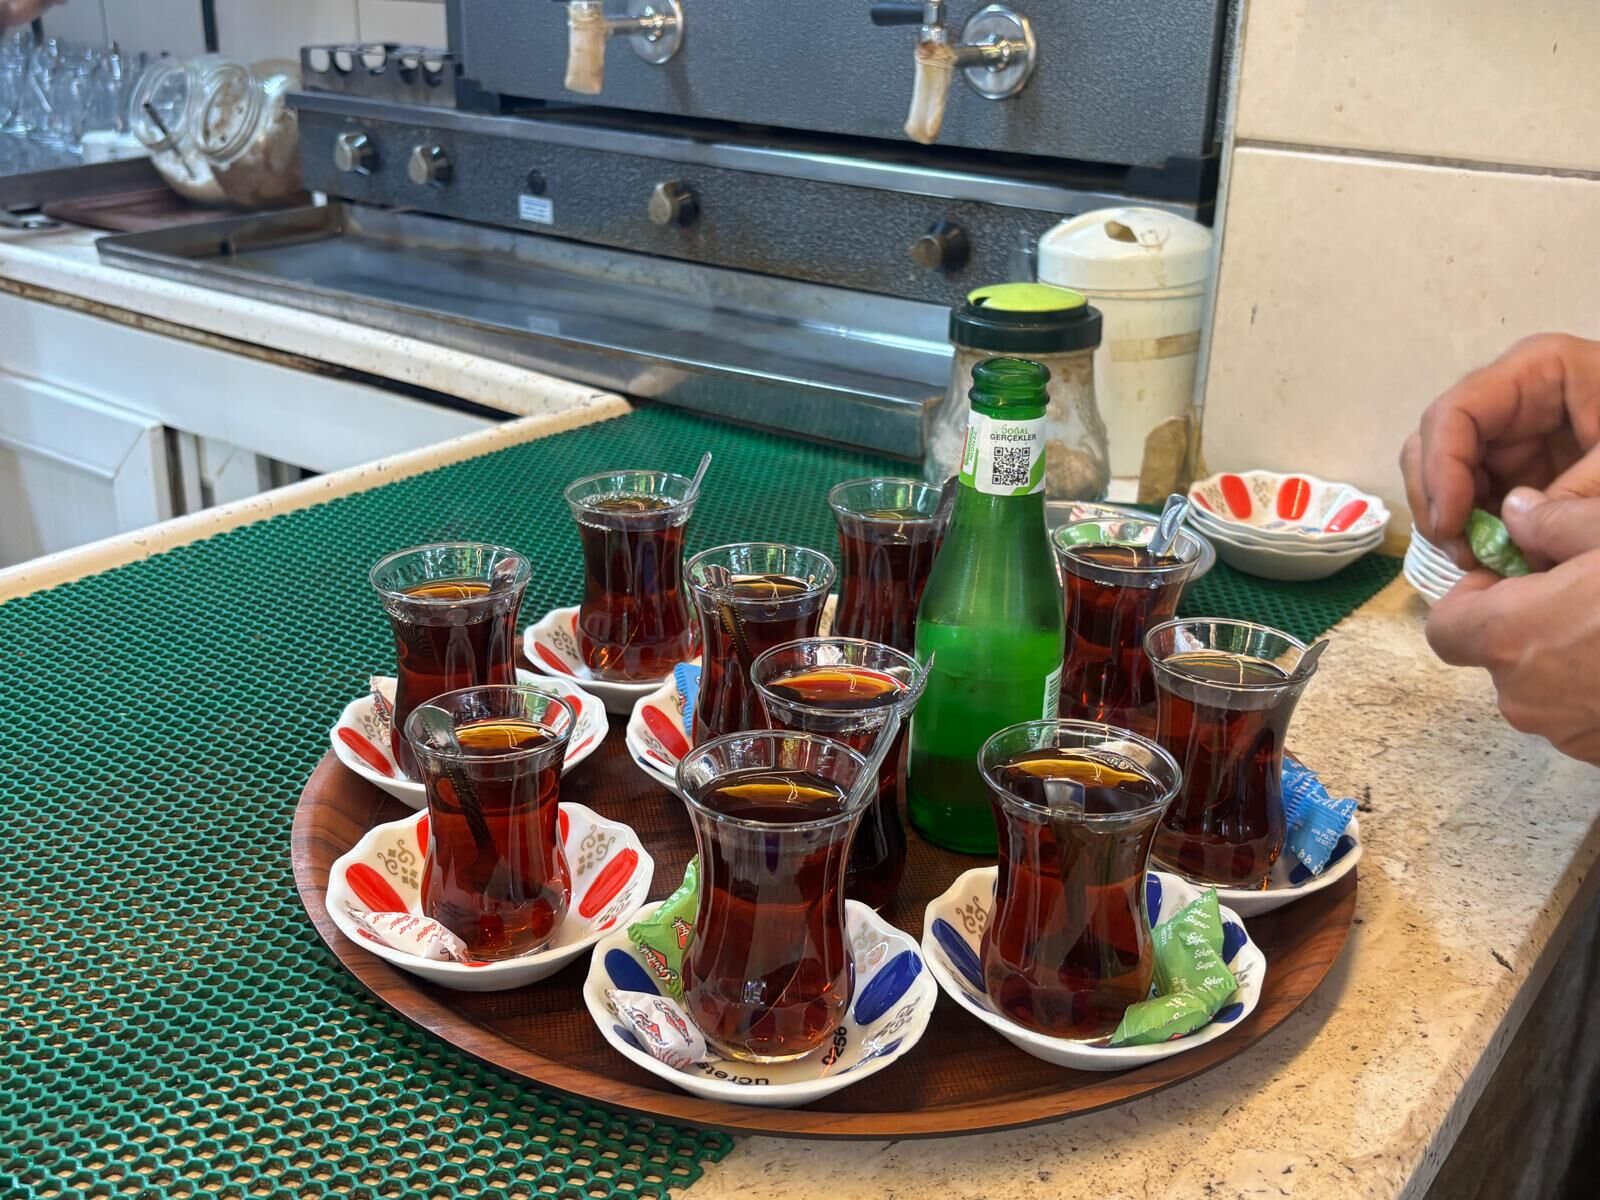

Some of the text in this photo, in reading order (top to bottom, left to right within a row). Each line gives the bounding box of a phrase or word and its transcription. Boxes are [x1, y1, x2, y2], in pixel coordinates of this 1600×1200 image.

[1001, 427, 1029, 435] DOĞAL
[990, 433, 1037, 442] GERÇEKLER
[822, 1026, 848, 1066] 0256
